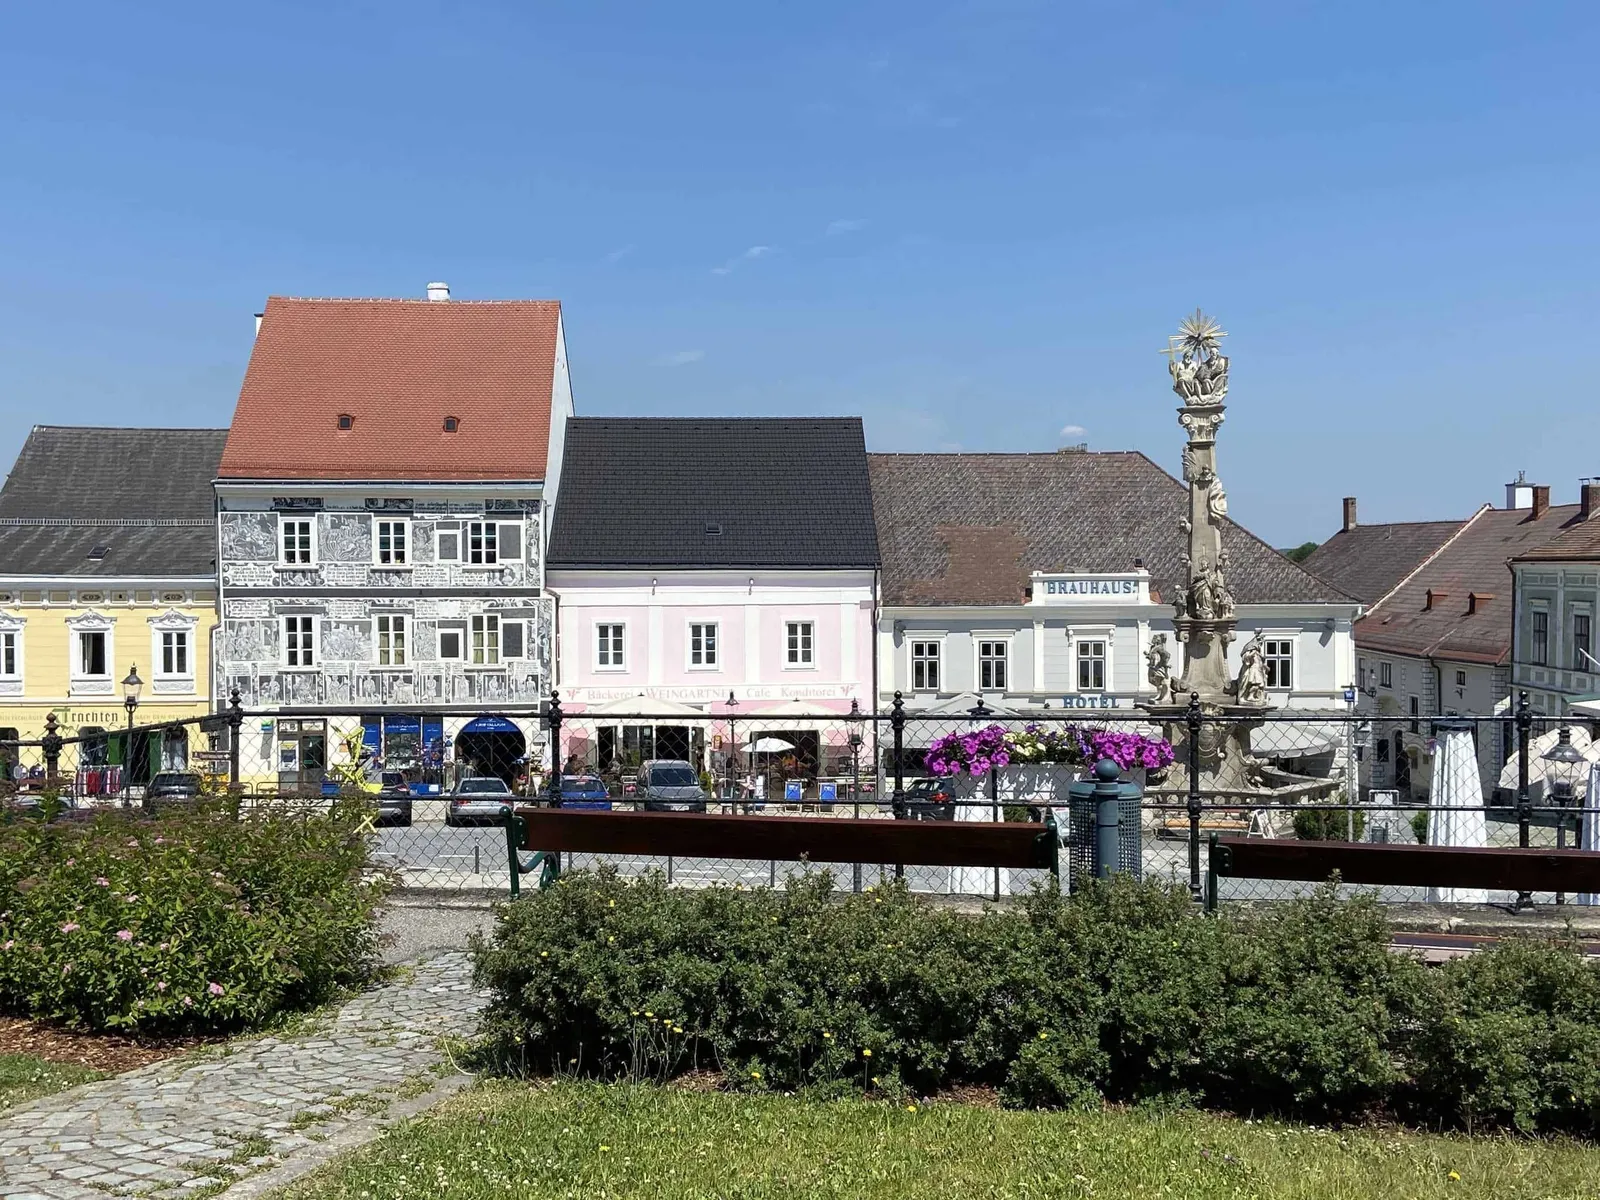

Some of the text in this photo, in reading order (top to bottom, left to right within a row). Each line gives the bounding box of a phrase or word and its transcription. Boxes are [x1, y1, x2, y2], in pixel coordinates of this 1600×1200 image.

[645, 687, 736, 700] WEINGARTNE
[781, 687, 836, 697] Konditorei
[1062, 697, 1120, 708] HOTEL
[52, 708, 118, 723] Trachten
